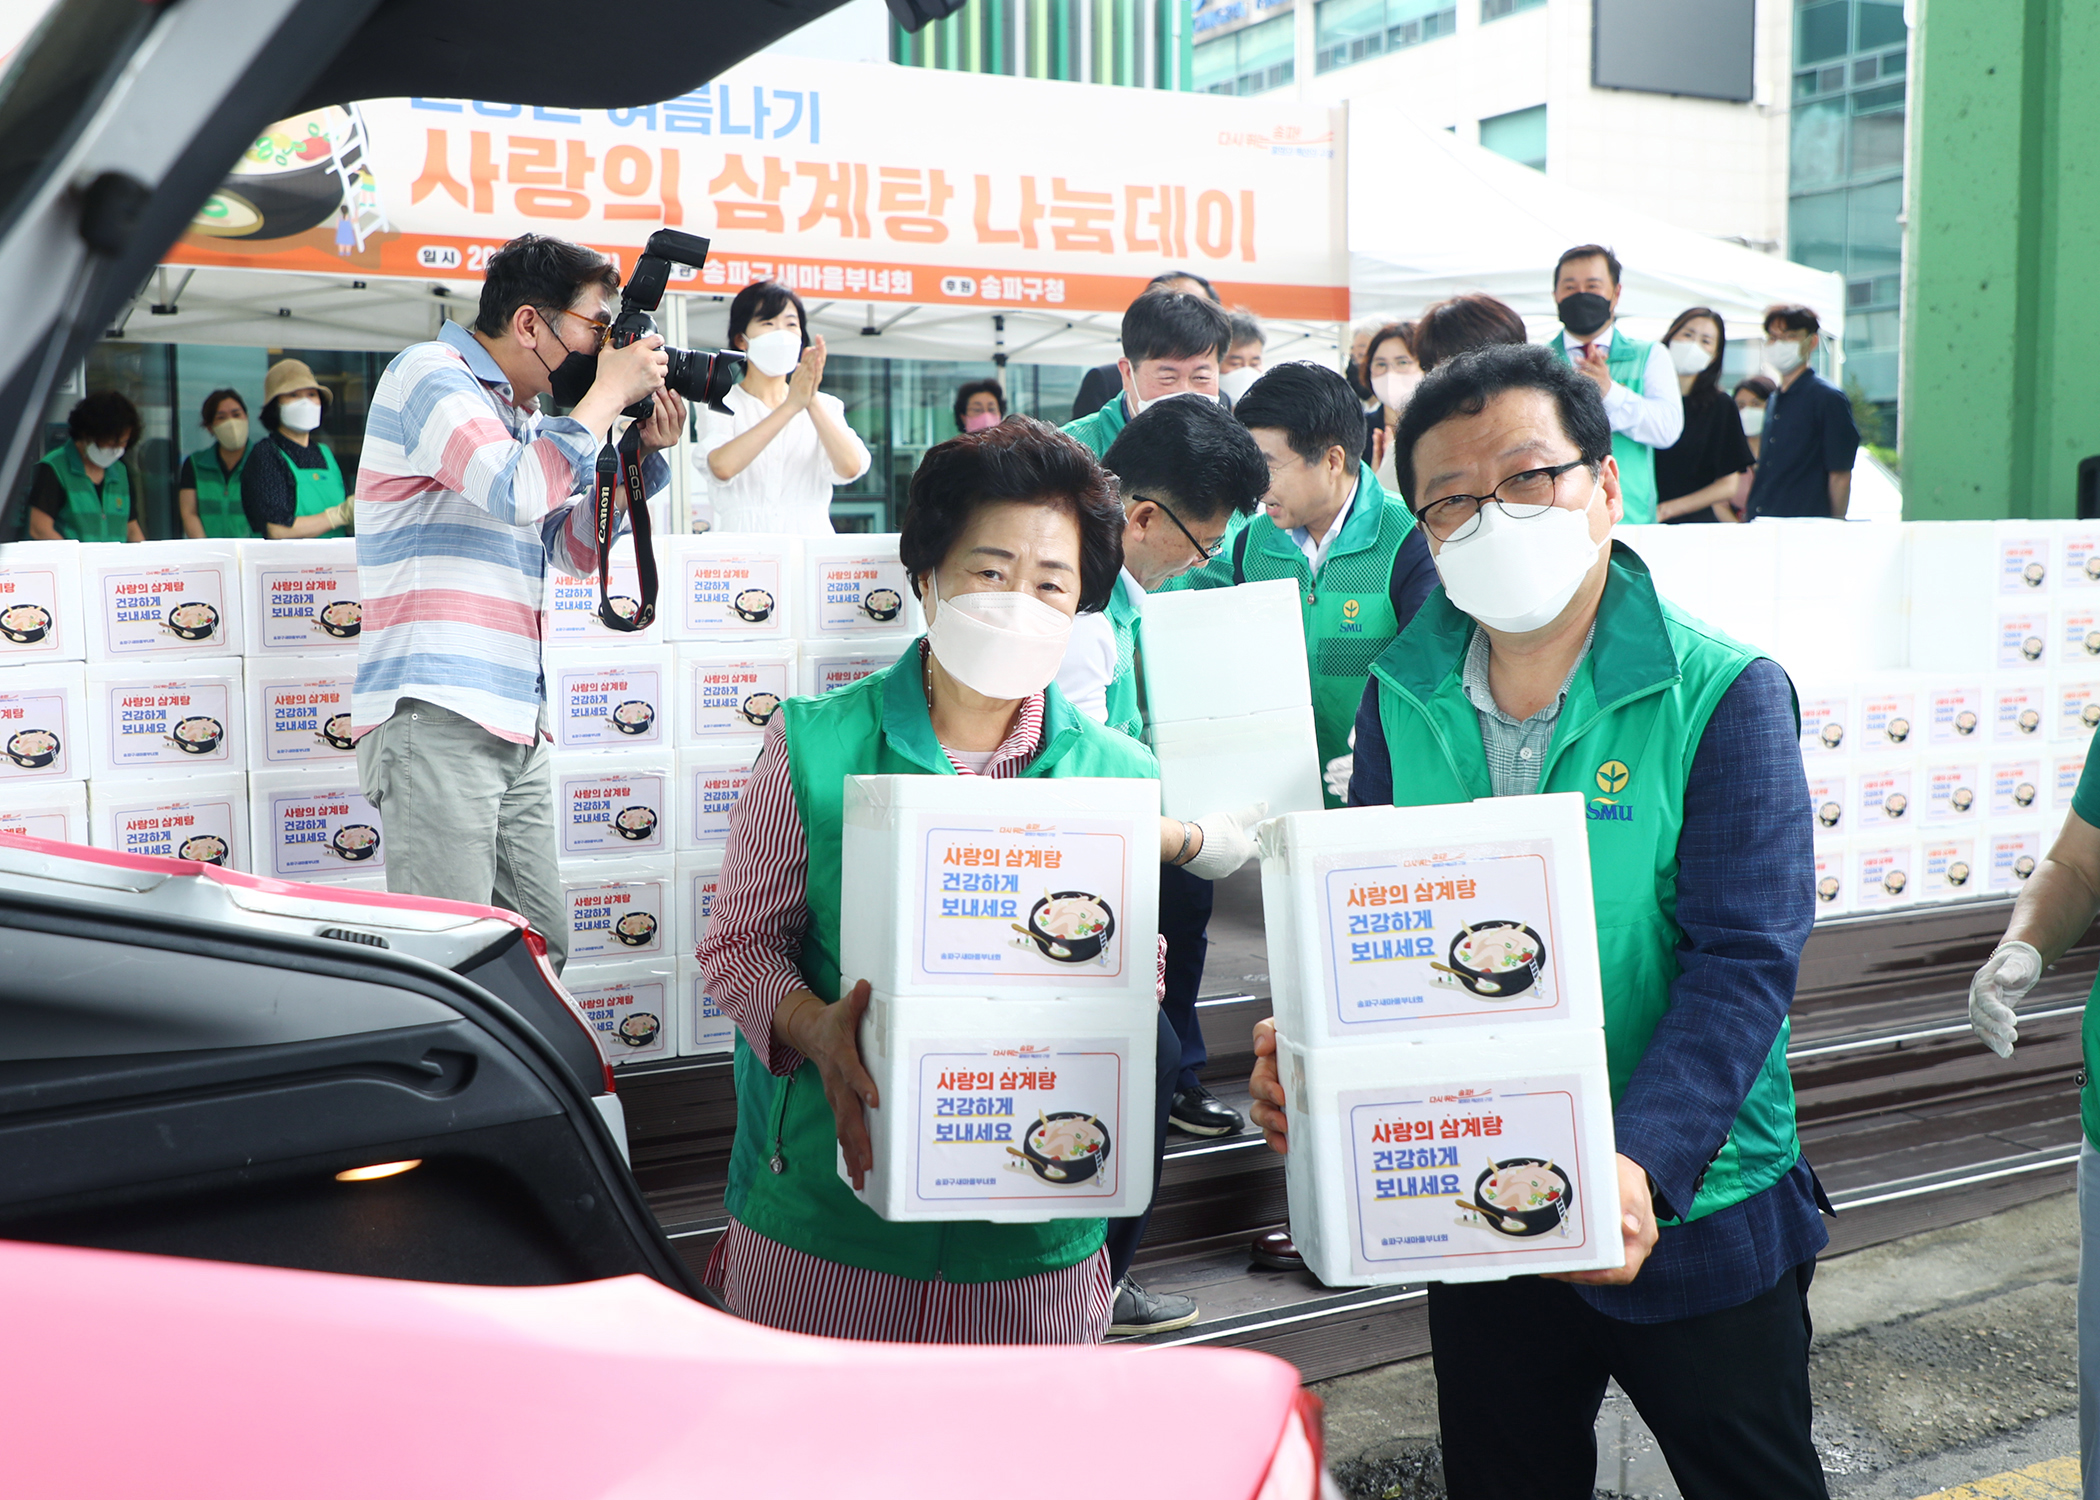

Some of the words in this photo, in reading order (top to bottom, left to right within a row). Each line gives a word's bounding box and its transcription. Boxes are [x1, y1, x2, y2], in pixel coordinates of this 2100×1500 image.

[411, 130, 684, 226] 사랑의
[709, 153, 954, 246] 삼계탕
[973, 173, 1257, 263] 나눔데이
[423, 249, 455, 265] 일시
[702, 258, 914, 296] 송파구새마을부녀회
[980, 274, 1066, 303] 송파구청
[628, 464, 643, 501] EOS
[598, 486, 610, 543] Canon
[695, 581, 729, 590] 건강하게
[828, 582, 860, 591] 건강하게
[556, 588, 592, 597] 건강하게
[695, 593, 729, 602] 보내세요
[116, 596, 160, 608] 건강하게
[272, 594, 314, 604] 건강하게
[828, 594, 860, 603] 보내세요
[556, 601, 592, 610] 보내세요
[117, 610, 161, 621] 보내세요
[272, 607, 314, 617] 보내세요
[1339, 623, 1363, 633] SMU
[852, 670, 875, 680] 삼계
[704, 686, 738, 695] 건강하게
[572, 695, 607, 704] 건강하게
[704, 698, 738, 707] 보내세요
[0, 709, 23, 719] 계탕
[122, 710, 166, 720] 건강하게
[276, 707, 317, 718] 건강하게
[571, 707, 608, 717] 보내세요
[122, 723, 166, 733] 보내세요
[276, 720, 317, 731] 보내세요
[704, 791, 738, 800] 건강하게
[574, 801, 610, 811] 건강하게
[704, 803, 733, 812] 보내세
[1586, 802, 1634, 821] SMU
[574, 813, 610, 823] 보내세요
[285, 819, 326, 830] 건강하게
[127, 831, 171, 843] 건강하게
[285, 832, 327, 843] 보내세요
[944, 848, 1000, 866] 사랑의
[1006, 850, 1062, 868] 삼계탕
[944, 873, 1018, 891] 건강하게
[1348, 885, 1408, 907] 사랑의
[1415, 880, 1476, 902] 삼계탕
[575, 908, 611, 918] 건강하게
[942, 899, 1017, 917] 보내세요
[574, 920, 611, 930] 보내세요
[1349, 910, 1434, 935] 건강하게
[1352, 937, 1435, 961] 보내세요
[587, 1009, 614, 1020] 강하게
[703, 1008, 725, 1017] 보내
[594, 1021, 614, 1030] 세요
[938, 1072, 994, 1090] 사랑의
[1000, 1072, 1057, 1090] 삼계탕
[937, 1097, 1013, 1115] 건강하게
[936, 1122, 1012, 1141] 보내세요
[1372, 1121, 1434, 1143] 사랑의
[1440, 1116, 1503, 1139] 삼계탕
[1374, 1146, 1458, 1170] 건강하게
[1376, 1174, 1460, 1198] 보내세요
